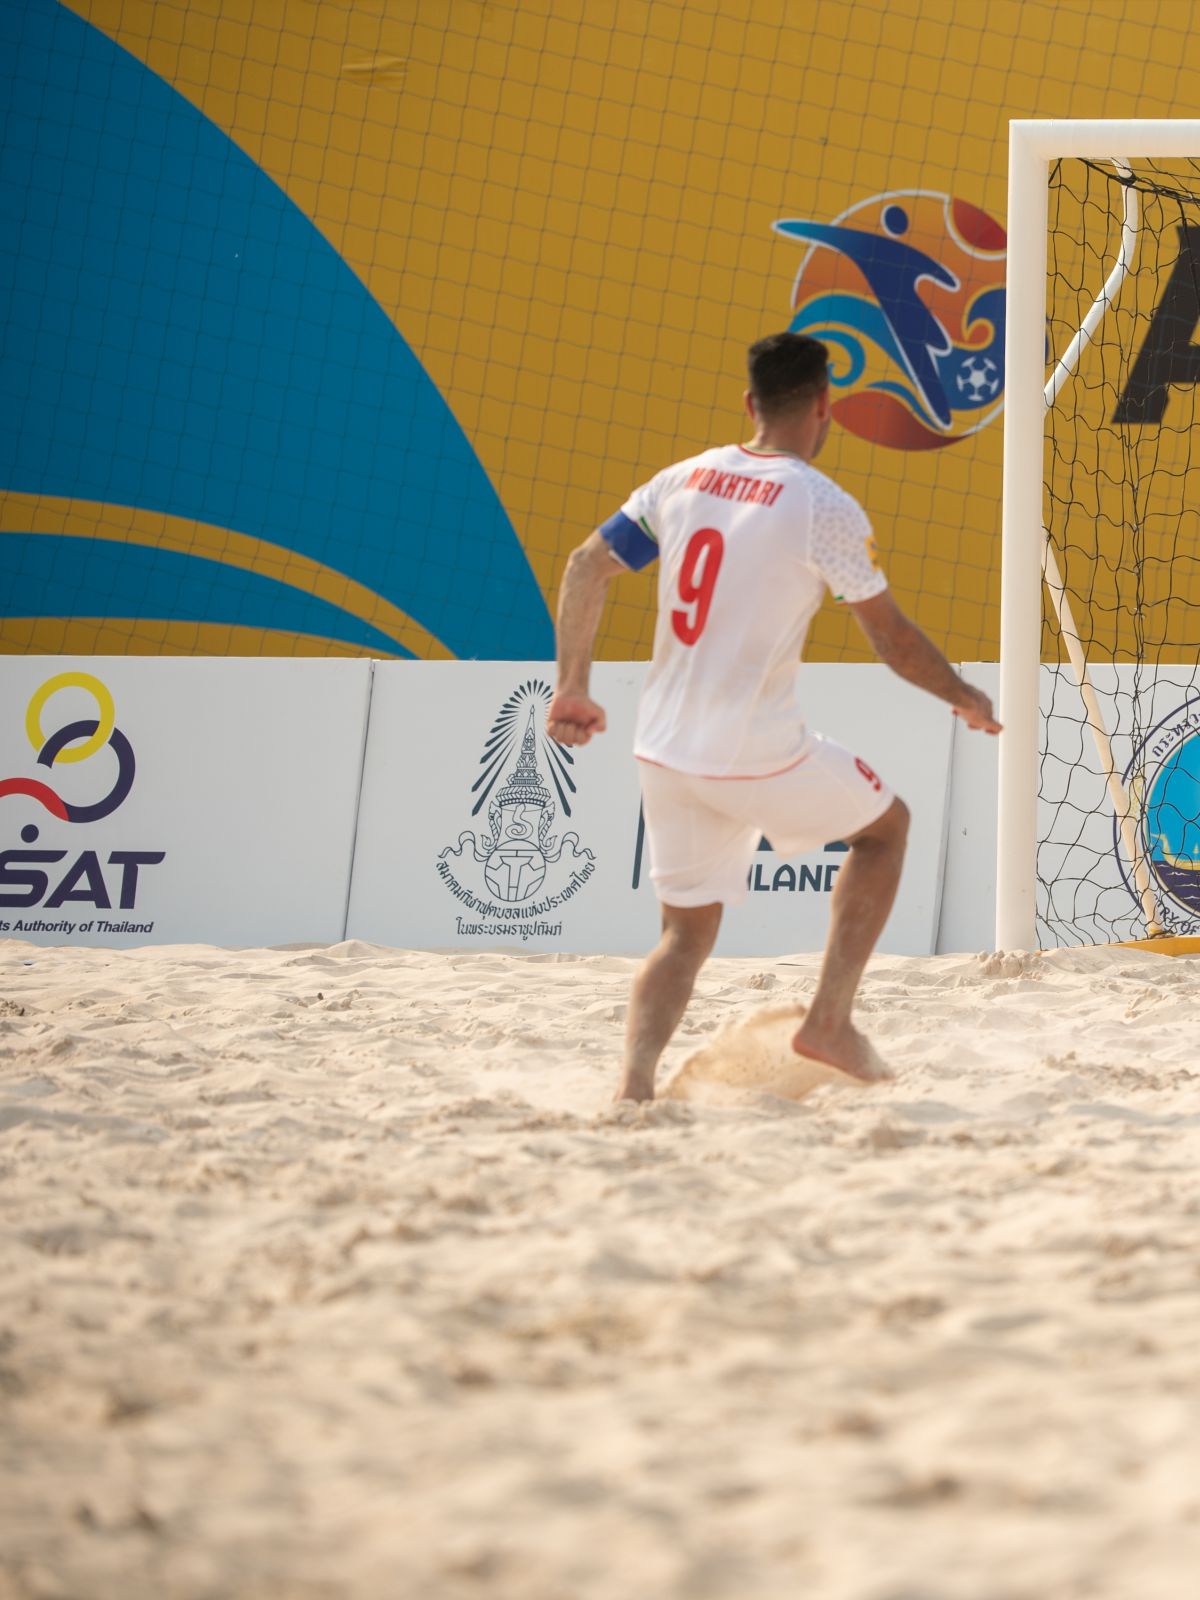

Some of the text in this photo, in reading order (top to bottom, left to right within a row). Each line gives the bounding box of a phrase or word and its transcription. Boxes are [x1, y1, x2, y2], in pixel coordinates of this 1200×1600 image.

[684, 467, 784, 507] MOKHTARI
[671, 527, 724, 646] 9
[854, 756, 881, 791] 9
[0, 850, 166, 909] SAT
[13, 920, 76, 935] Authority
[79, 921, 95, 932] of
[97, 921, 154, 933] Thailand
